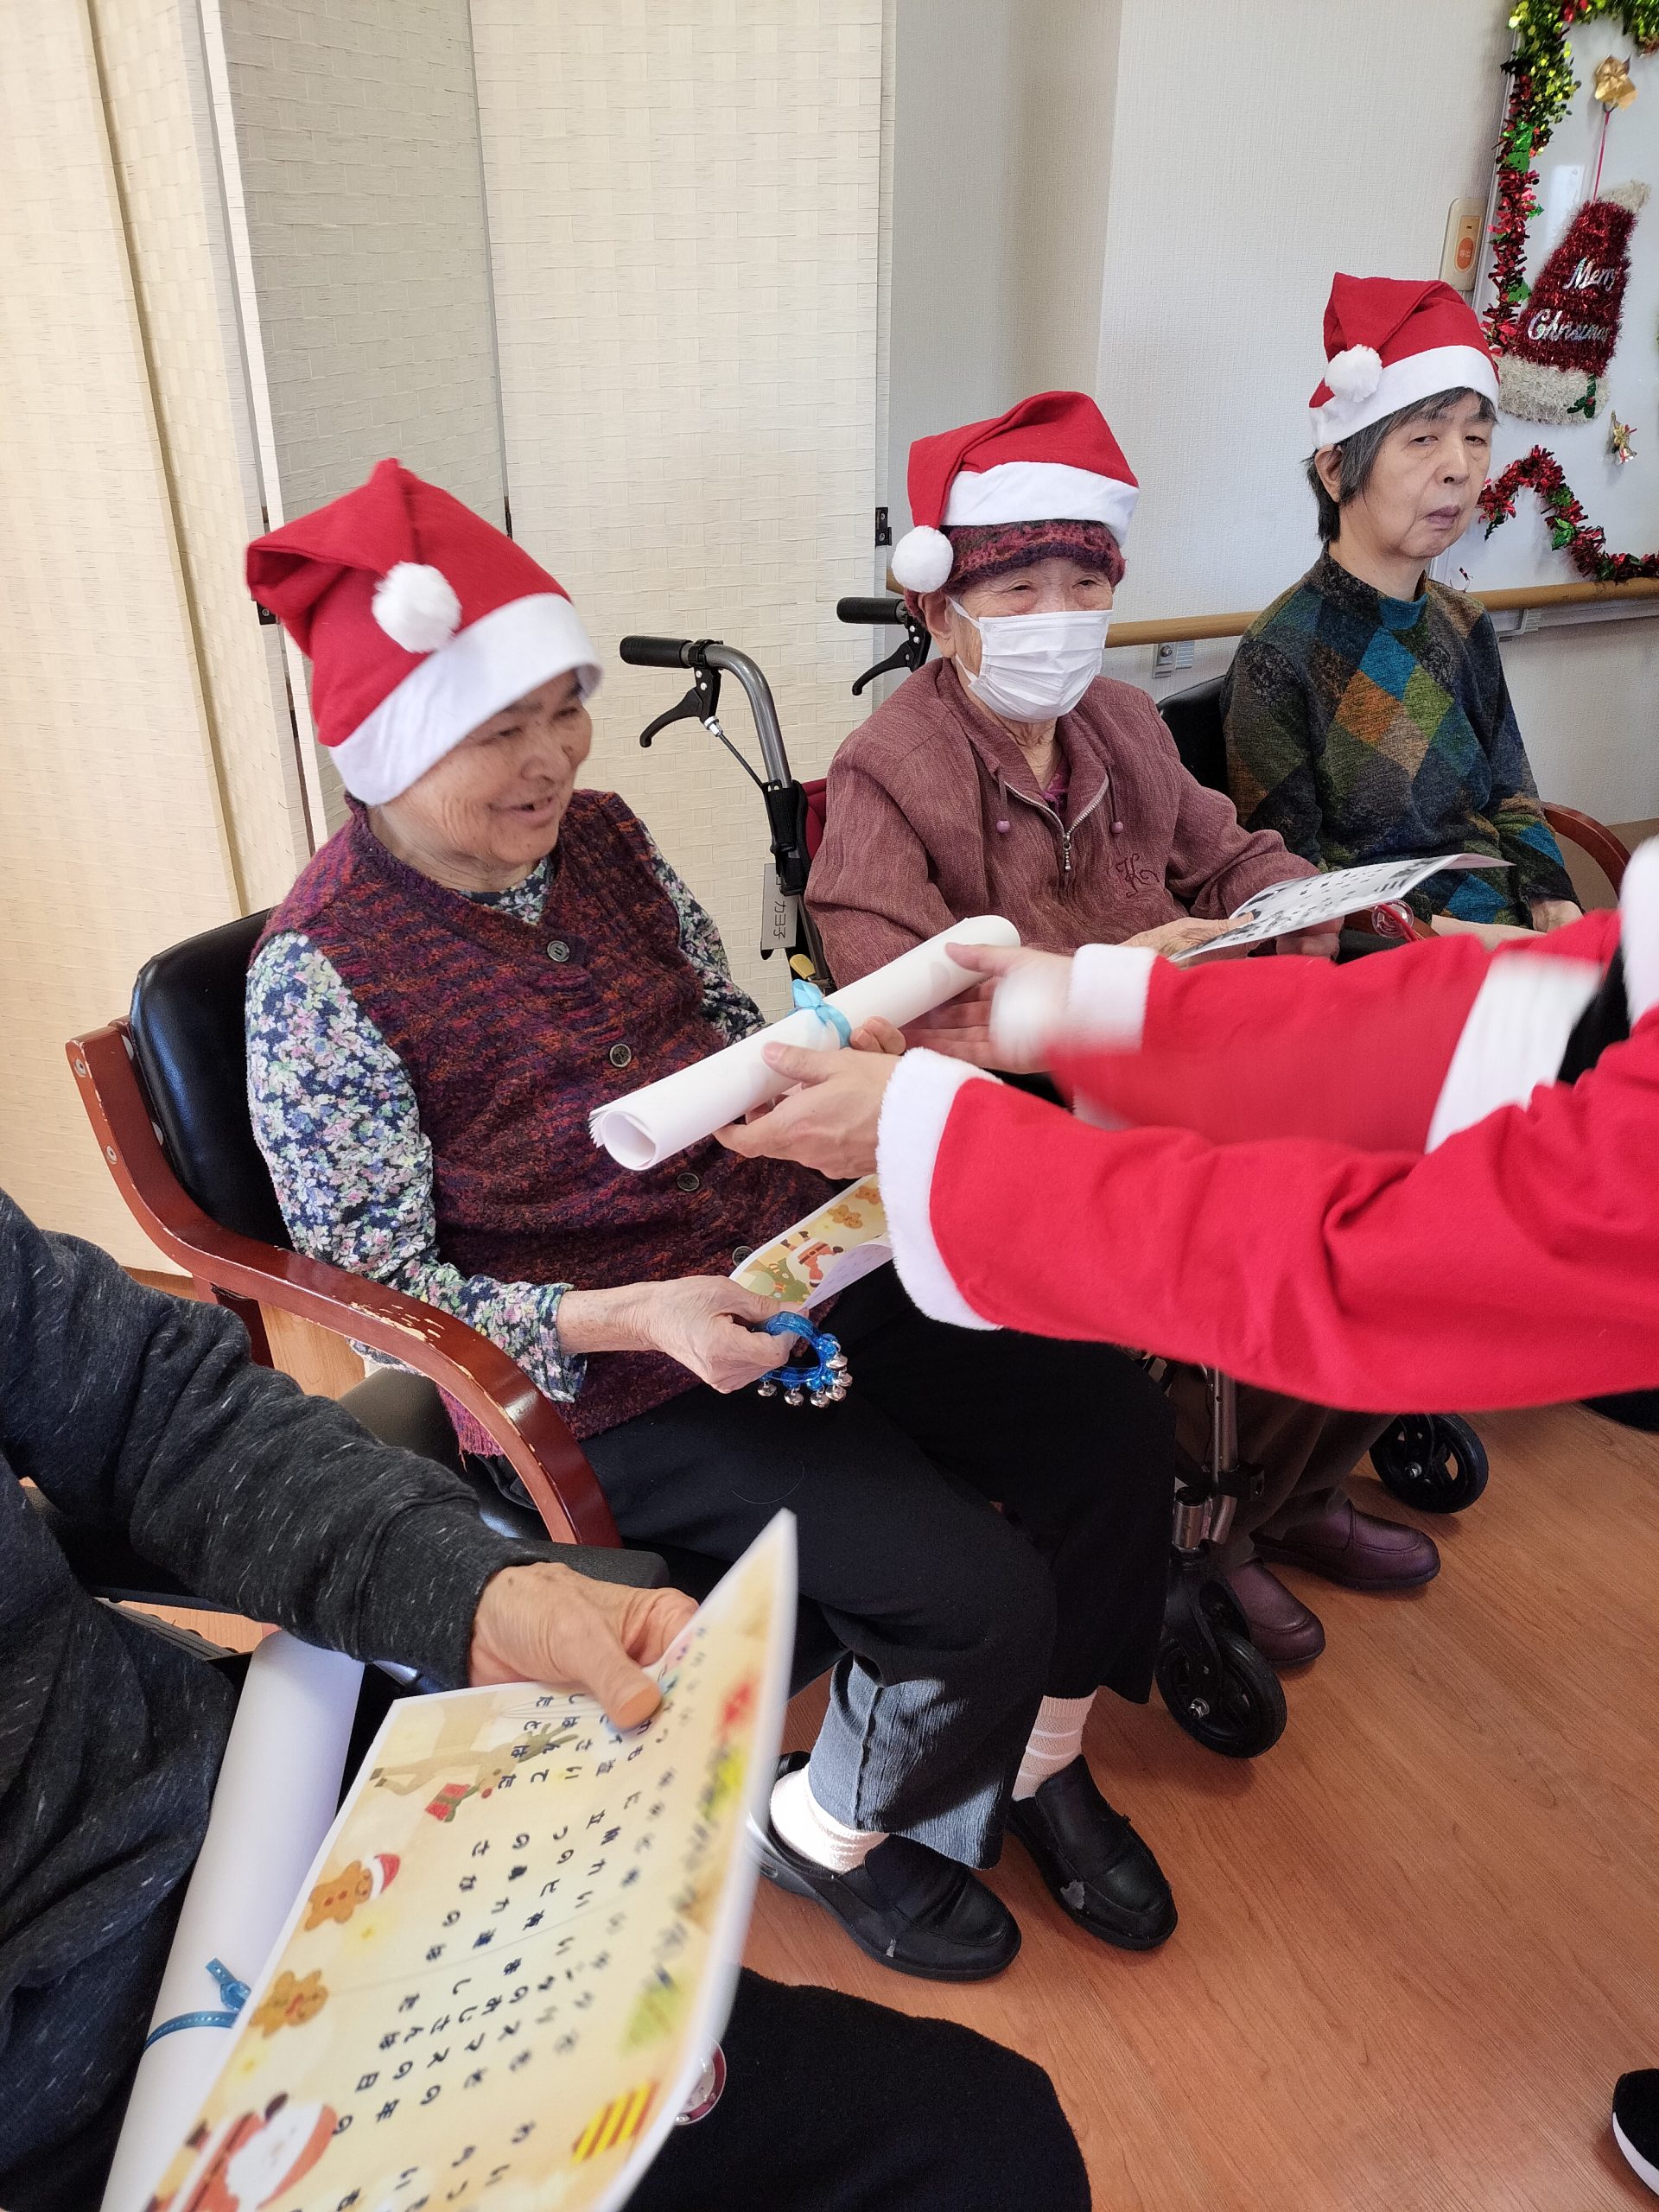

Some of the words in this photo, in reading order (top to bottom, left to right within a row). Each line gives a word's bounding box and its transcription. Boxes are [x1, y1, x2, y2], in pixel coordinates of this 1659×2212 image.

[1562, 257, 1615, 291] Merry
[773, 900, 787, 940] カヨ子
[290, 2120, 537, 2212] わらいも
